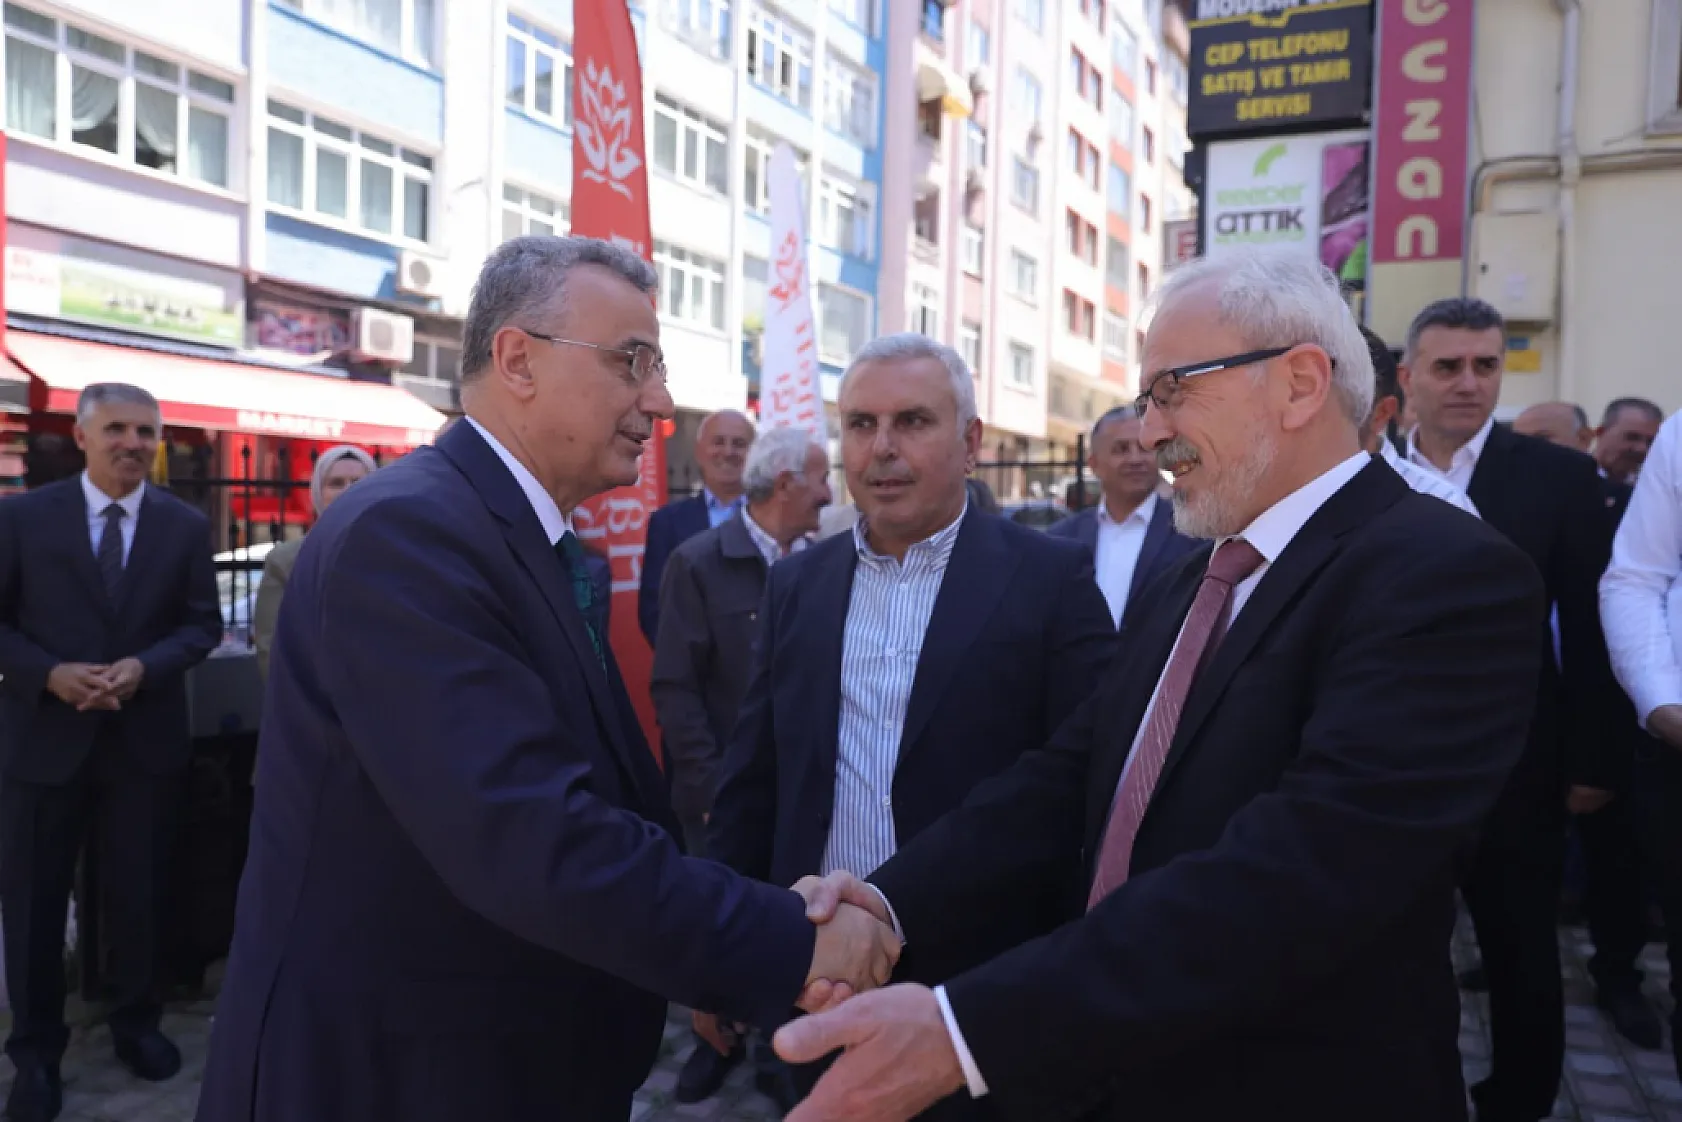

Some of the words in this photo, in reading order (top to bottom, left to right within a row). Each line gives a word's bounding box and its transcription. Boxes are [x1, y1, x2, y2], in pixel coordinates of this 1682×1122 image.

[1205, 42, 1245, 67] CEP
[1247, 29, 1349, 62] TELEFONU
[1260, 66, 1285, 88] VE
[238, 410, 343, 437] MARKET
